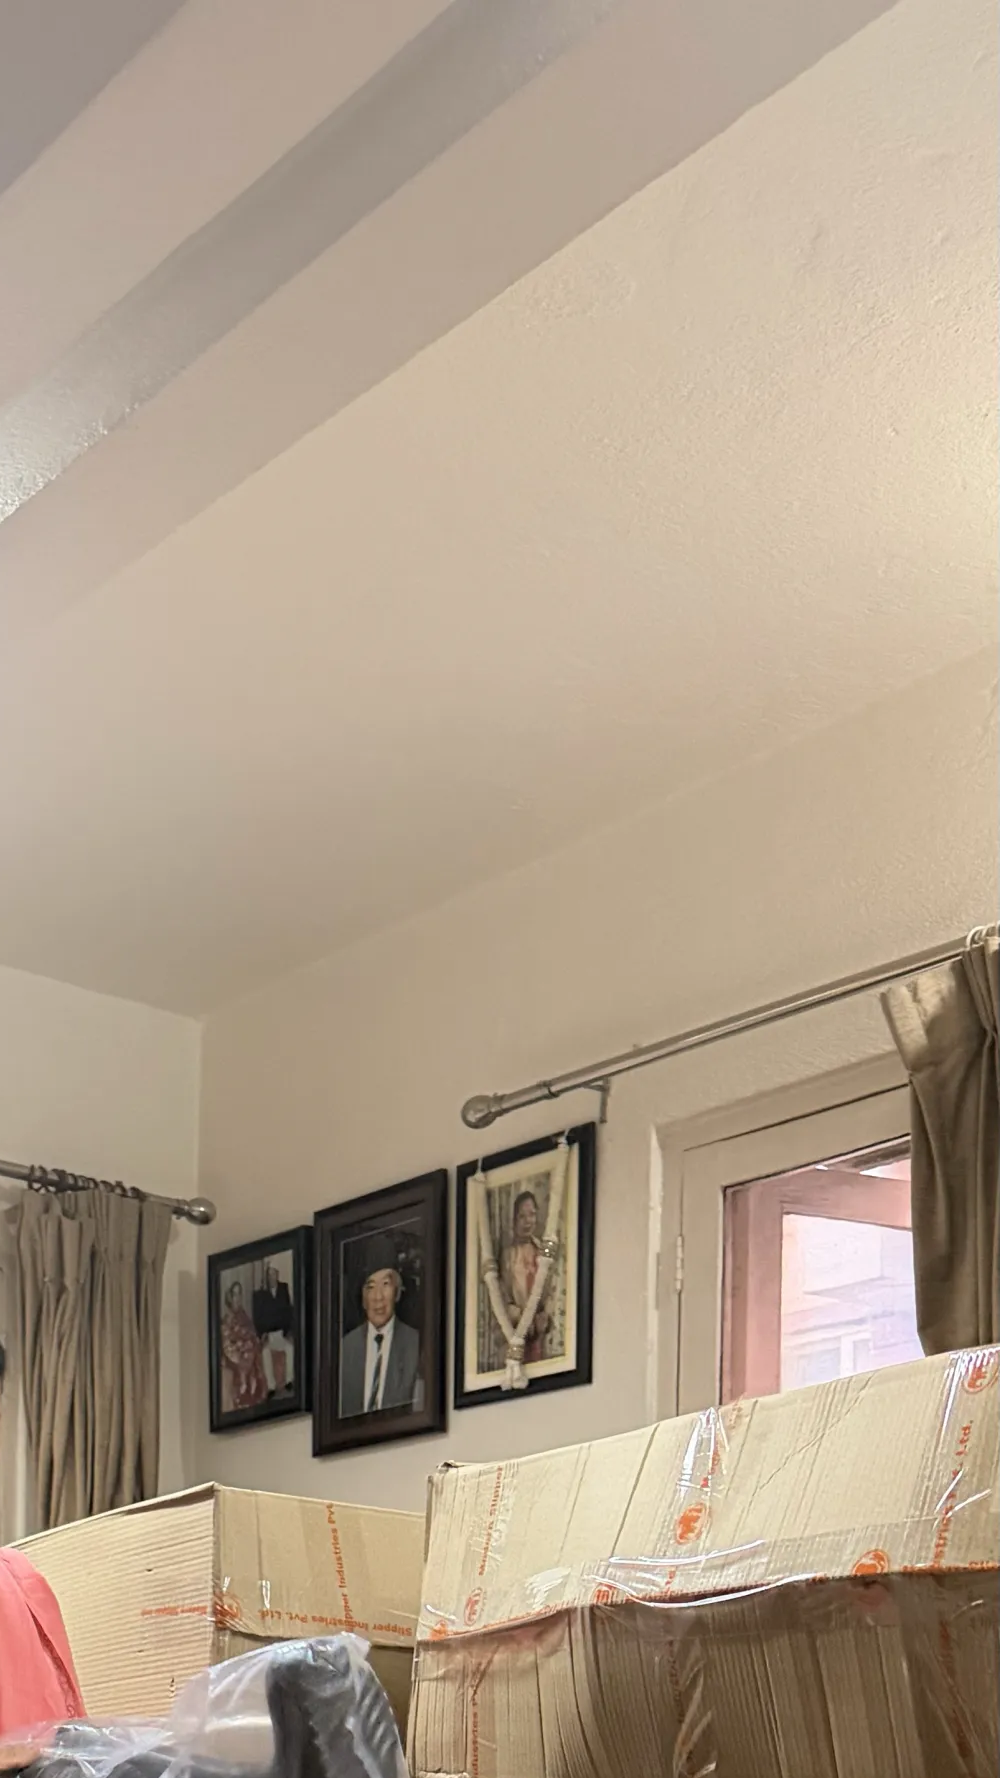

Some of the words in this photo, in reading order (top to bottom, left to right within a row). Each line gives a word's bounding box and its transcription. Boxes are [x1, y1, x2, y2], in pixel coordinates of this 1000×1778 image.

[329, 1527, 347, 1588] Industries
[256, 1609, 282, 1622] Ltd.
[285, 1610, 309, 1625] Pvt.
[310, 1616, 371, 1632] Industries
[371, 1621, 412, 1637] Slipper
